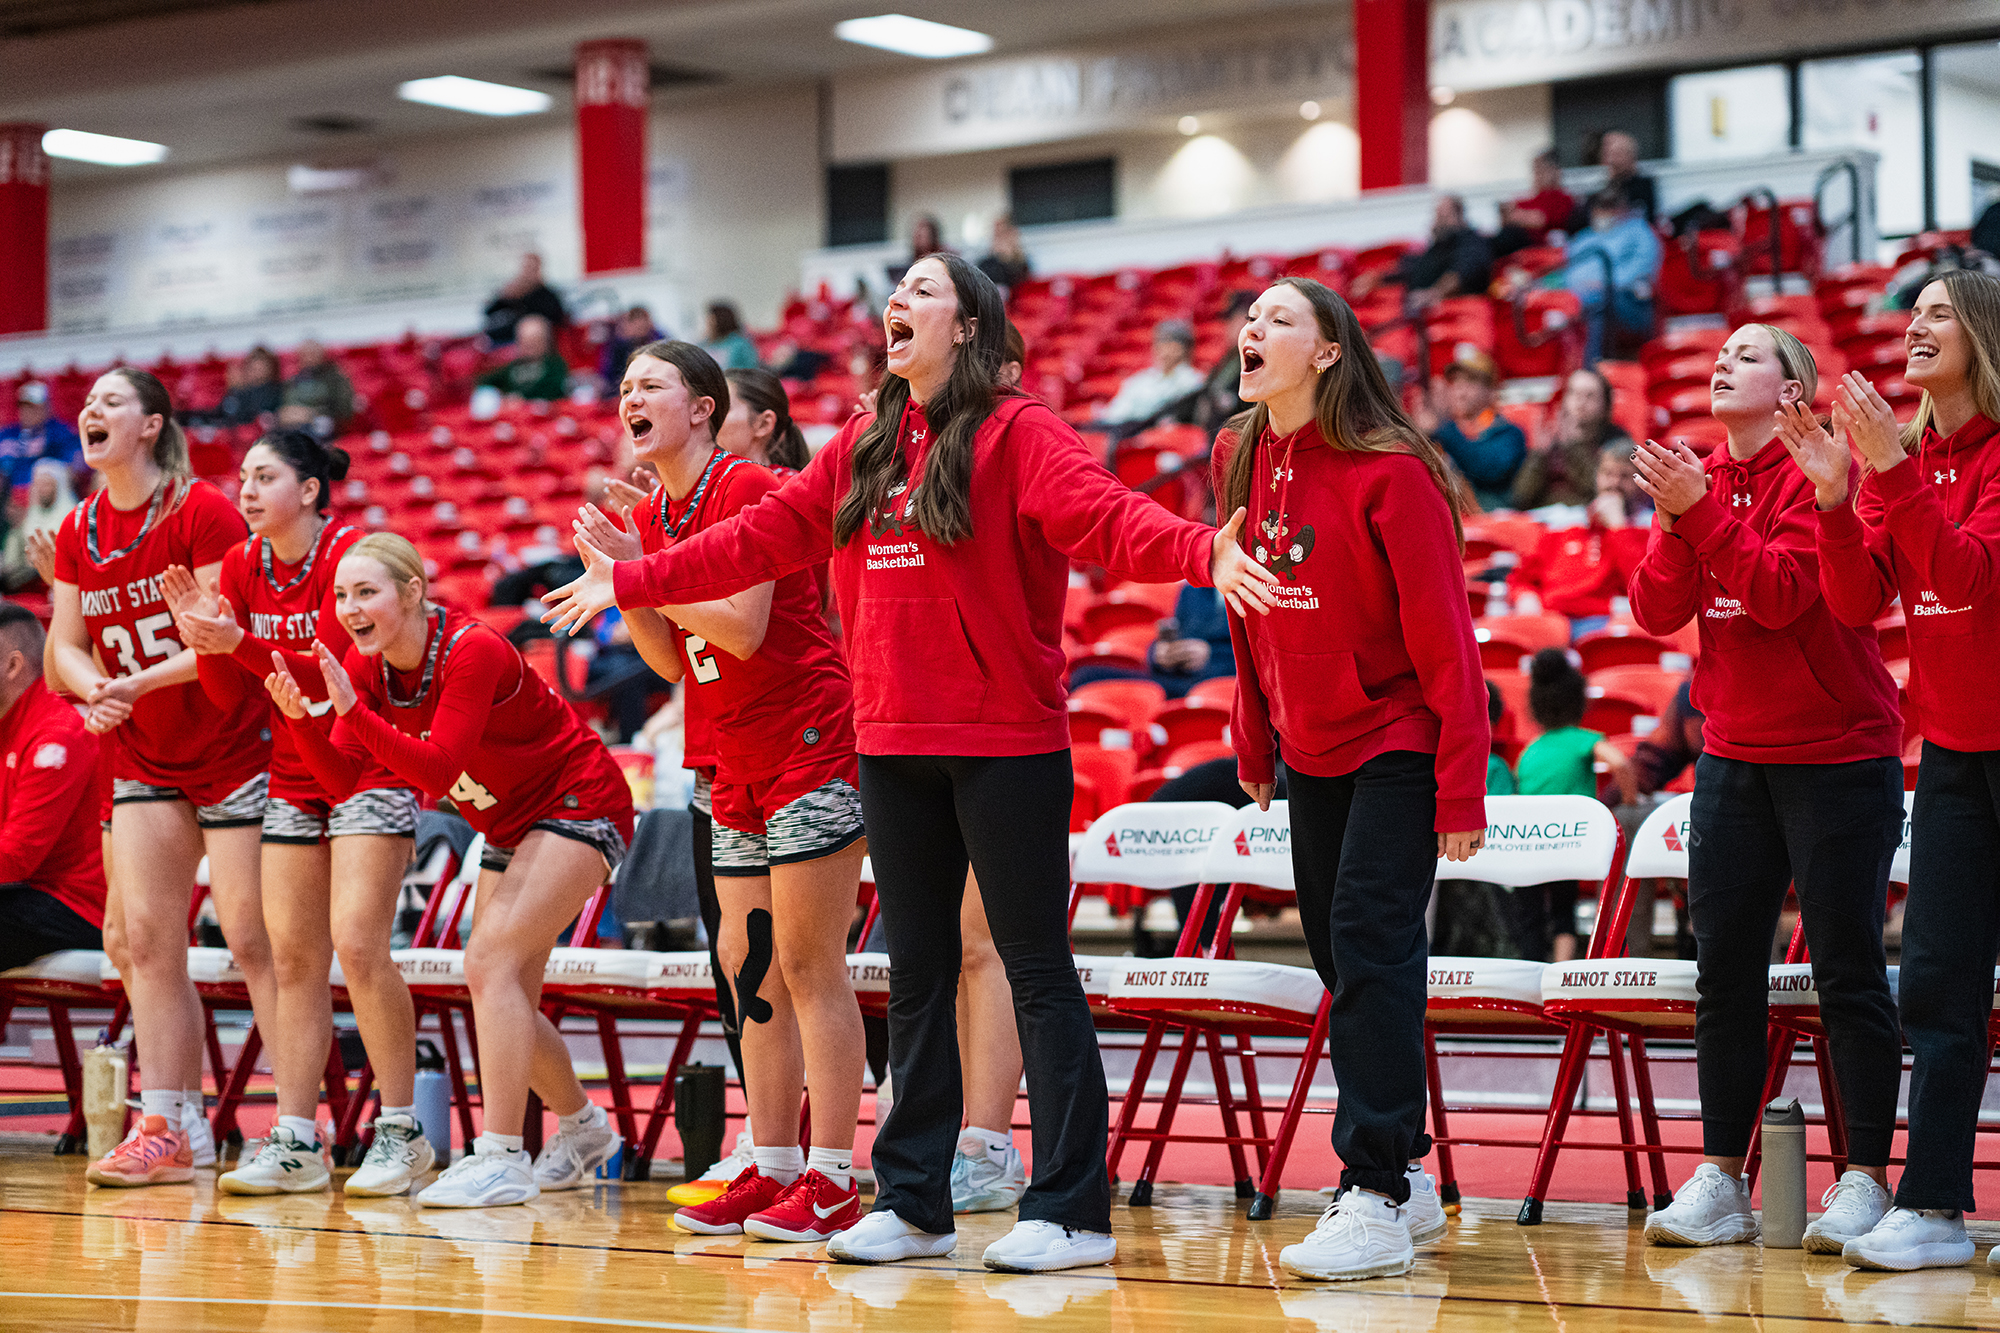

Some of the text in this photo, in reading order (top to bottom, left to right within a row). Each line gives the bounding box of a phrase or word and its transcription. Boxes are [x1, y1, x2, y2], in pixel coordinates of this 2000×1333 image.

[868, 541, 919, 556] Women's
[866, 554, 925, 570] Basketball
[1261, 595, 1319, 610] ketball
[101, 611, 182, 678] 35
[449, 770, 498, 811] 4
[1119, 826, 1219, 844] PINNACLE
[1486, 821, 1588, 839] INNACLE
[1485, 843, 1532, 851] MPLOYEE
[1124, 971, 1209, 987] MINOT STATE
[1428, 970, 1474, 985] STATE
[1561, 971, 1657, 987] MINOT STATE
[1770, 974, 1817, 992] MINO
